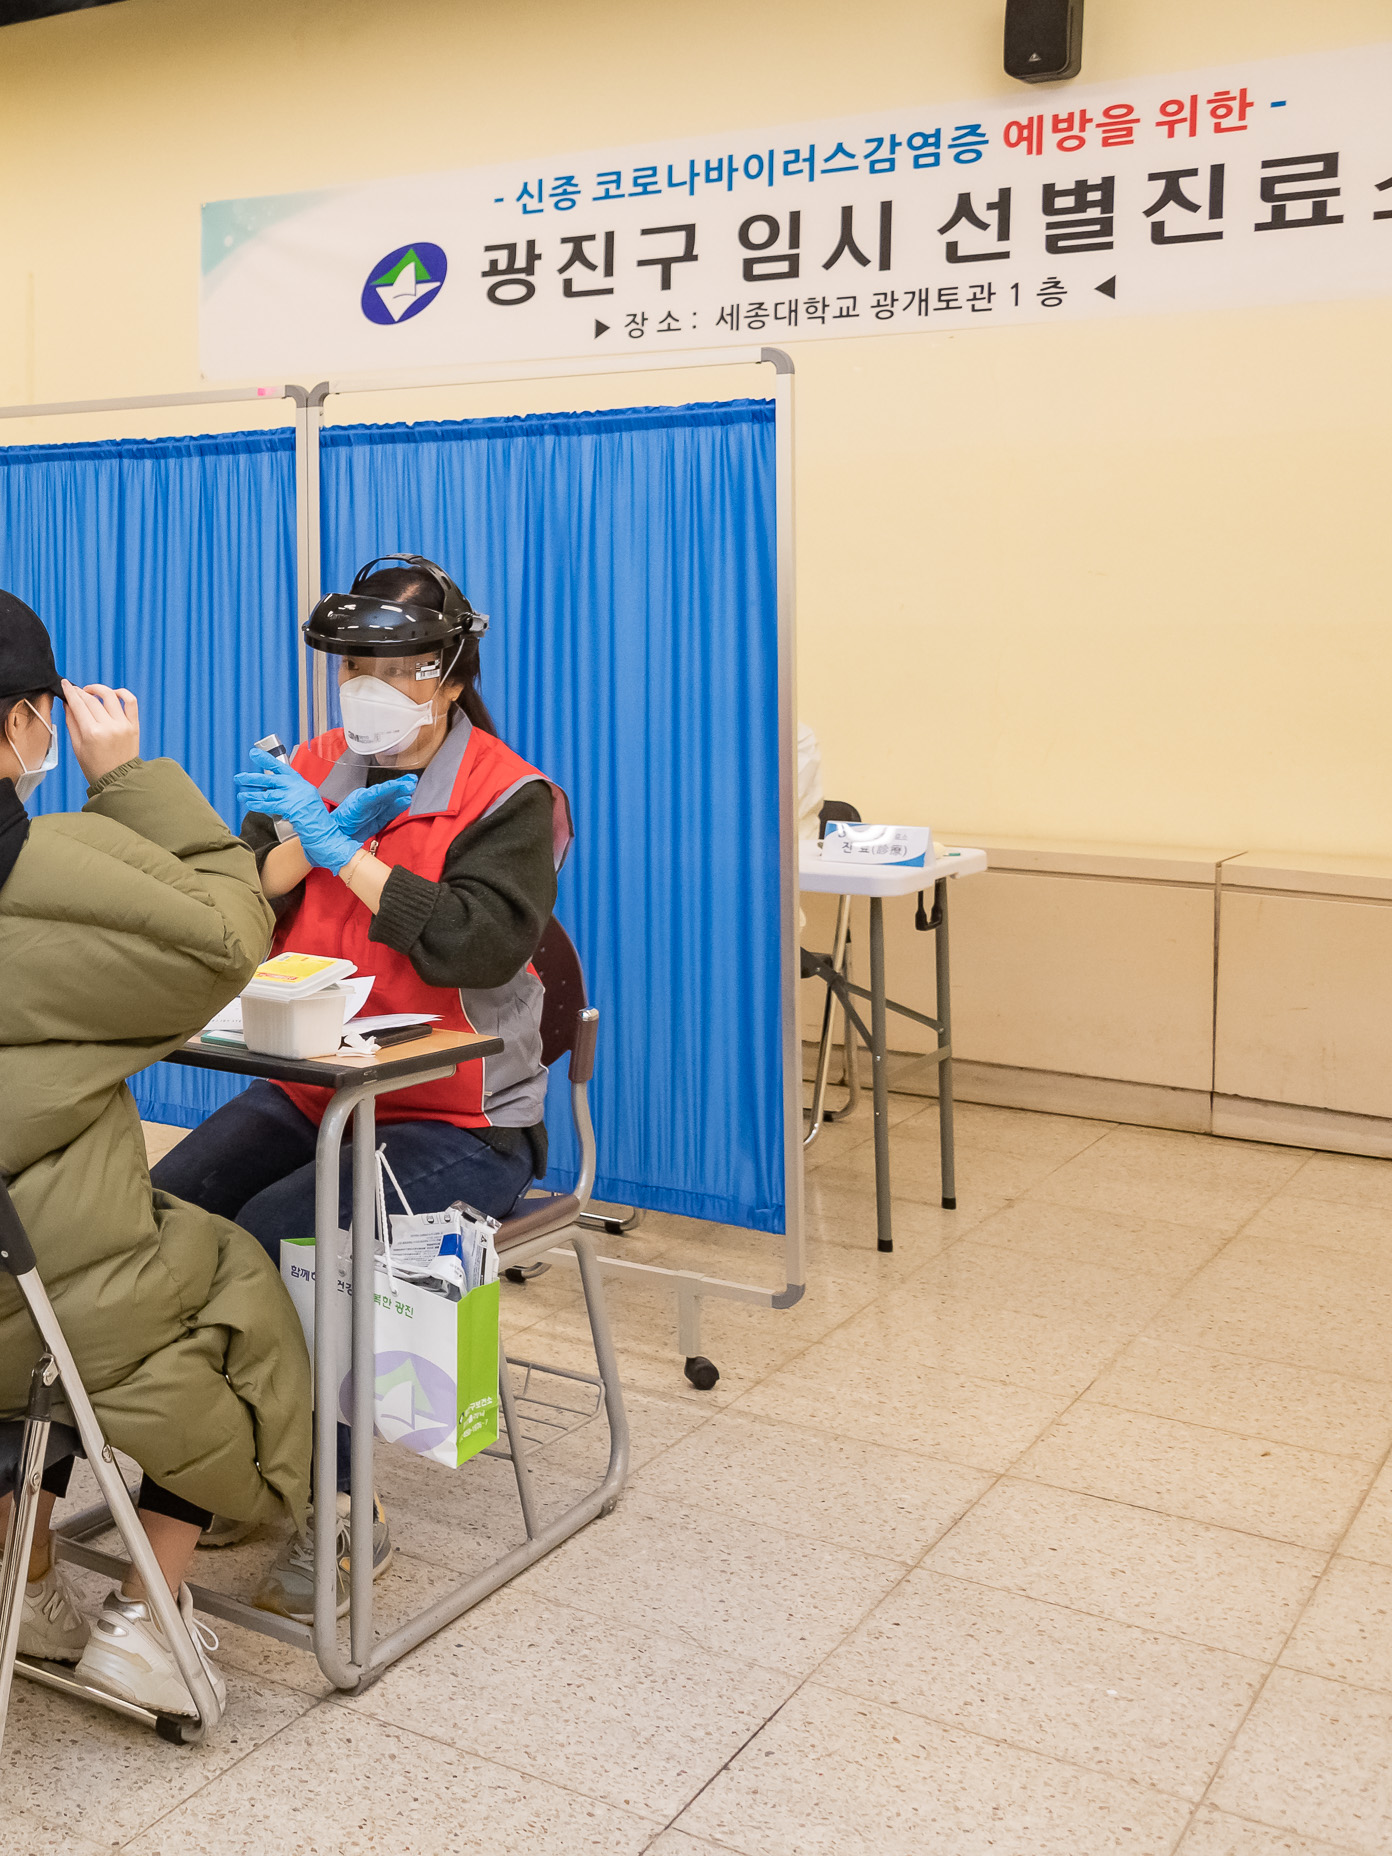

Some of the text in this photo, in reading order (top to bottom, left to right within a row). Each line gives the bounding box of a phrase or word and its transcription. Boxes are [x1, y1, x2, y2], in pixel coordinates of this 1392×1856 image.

[515, 174, 583, 216] 신종
[591, 122, 990, 204] 코로나바이러스감염증
[1002, 101, 1142, 157] 예방을
[1154, 87, 1256, 140] 위한
[480, 150, 1392, 307] 광진구 임시 선별진료
[715, 295, 860, 332] 세종대학교
[870, 281, 997, 321] 광개토관
[373, 1293, 392, 1310] 복한
[395, 1300, 414, 1319] 광진
